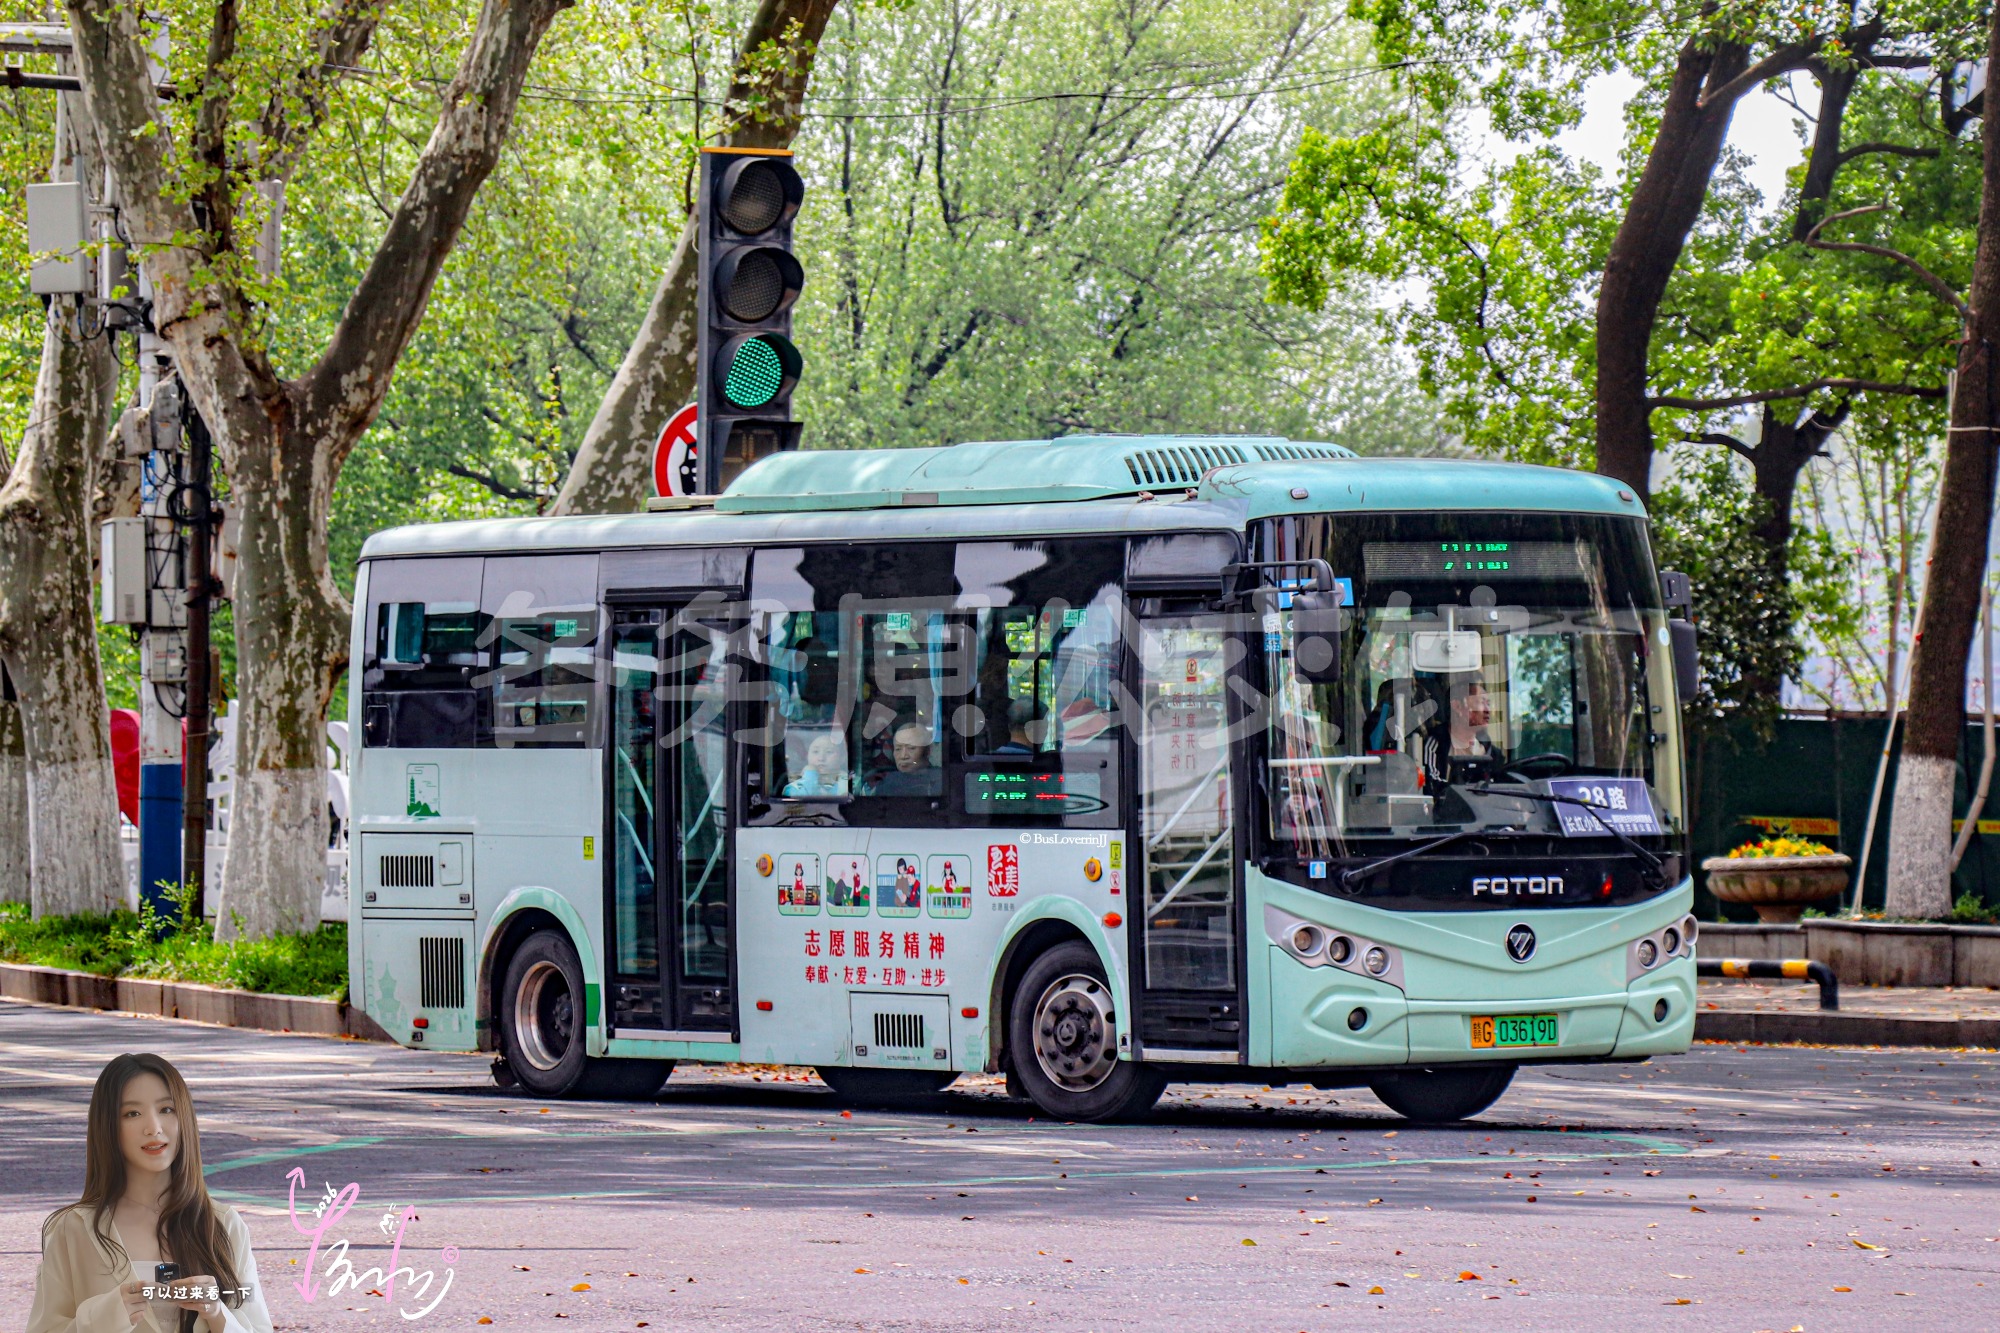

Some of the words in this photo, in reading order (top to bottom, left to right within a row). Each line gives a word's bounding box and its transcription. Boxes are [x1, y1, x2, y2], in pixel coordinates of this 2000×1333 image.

[1578, 786, 1628, 810] 28路
[1472, 876, 1564, 896] FOTON
[804, 929, 946, 960] 志愿服务精神
